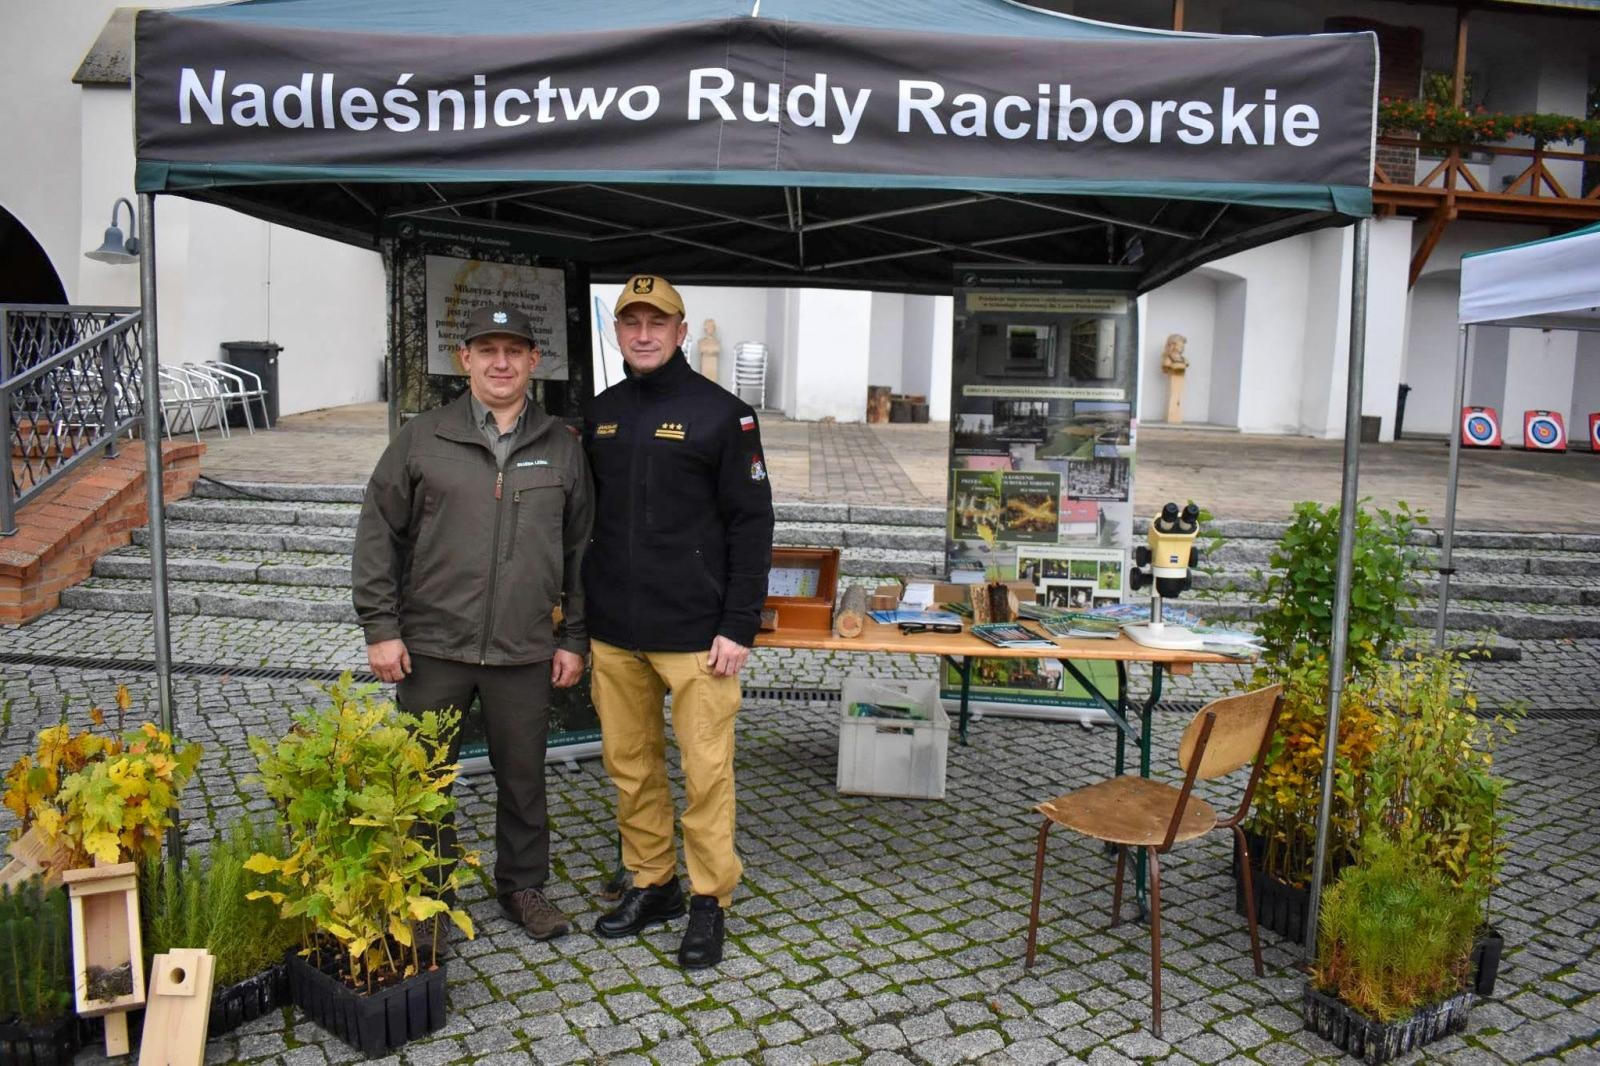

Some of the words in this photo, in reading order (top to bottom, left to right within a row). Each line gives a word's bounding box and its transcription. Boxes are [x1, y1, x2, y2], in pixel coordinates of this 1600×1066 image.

[179, 68, 660, 133] Nadleśnictwo
[687, 67, 873, 145] Rudy
[898, 79, 1320, 147] Raciborskie
